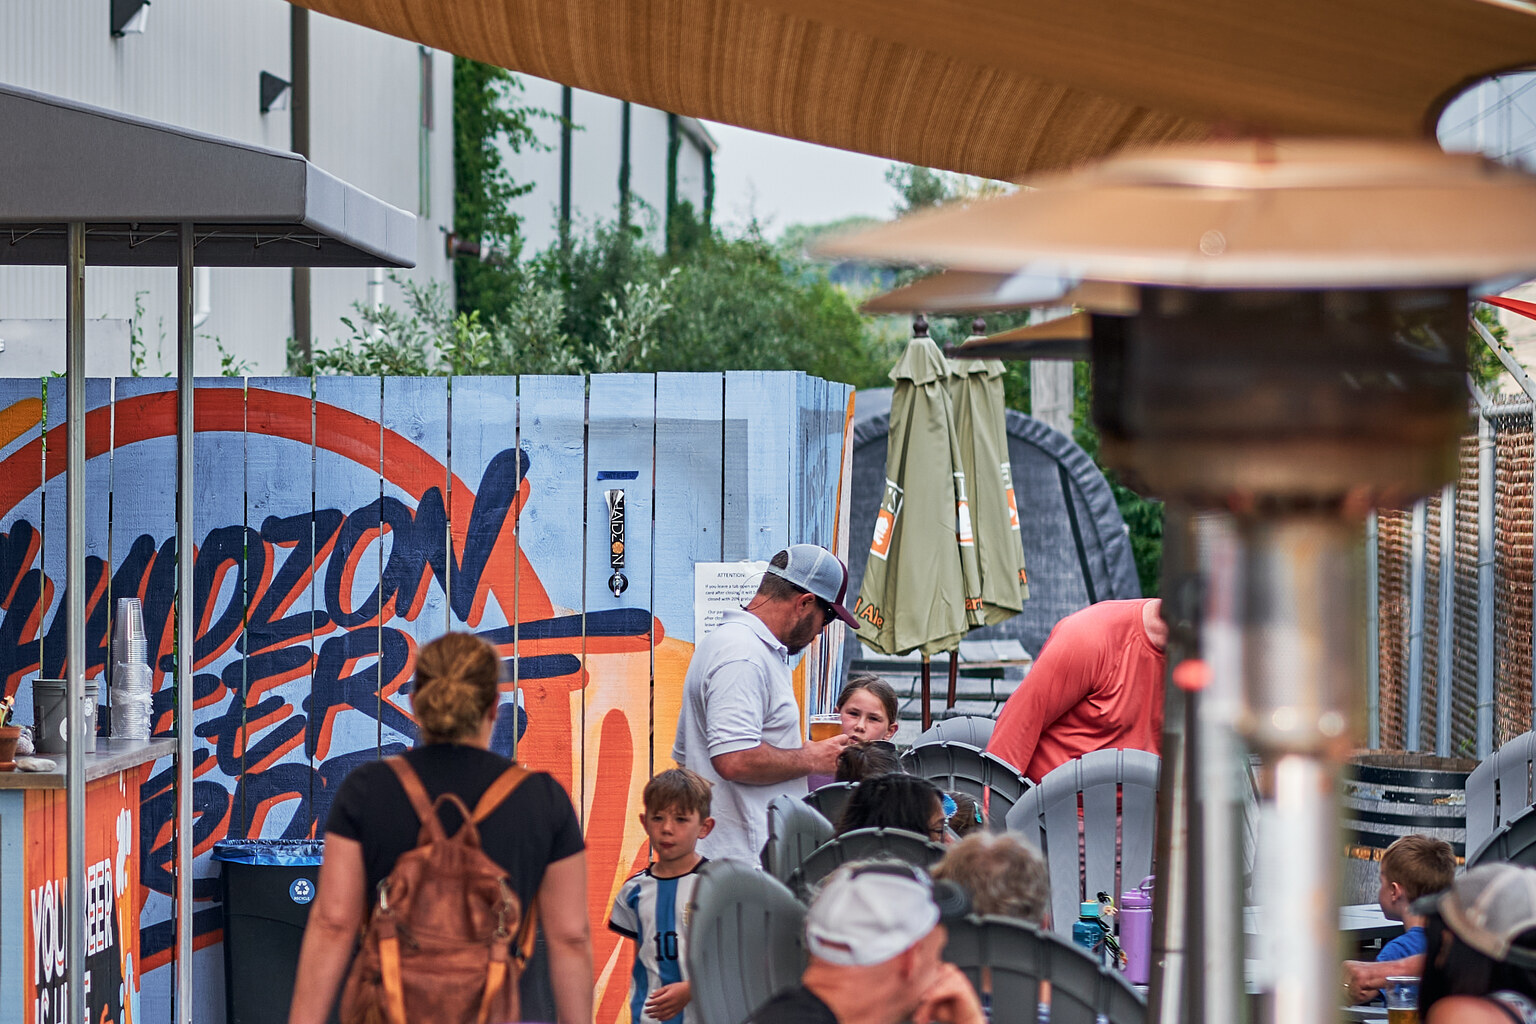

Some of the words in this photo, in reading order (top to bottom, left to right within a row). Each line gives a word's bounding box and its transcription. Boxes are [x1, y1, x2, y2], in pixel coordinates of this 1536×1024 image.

[860, 602, 885, 630] Ale
[30, 878, 68, 986] YOU
[653, 930, 679, 962] 10
